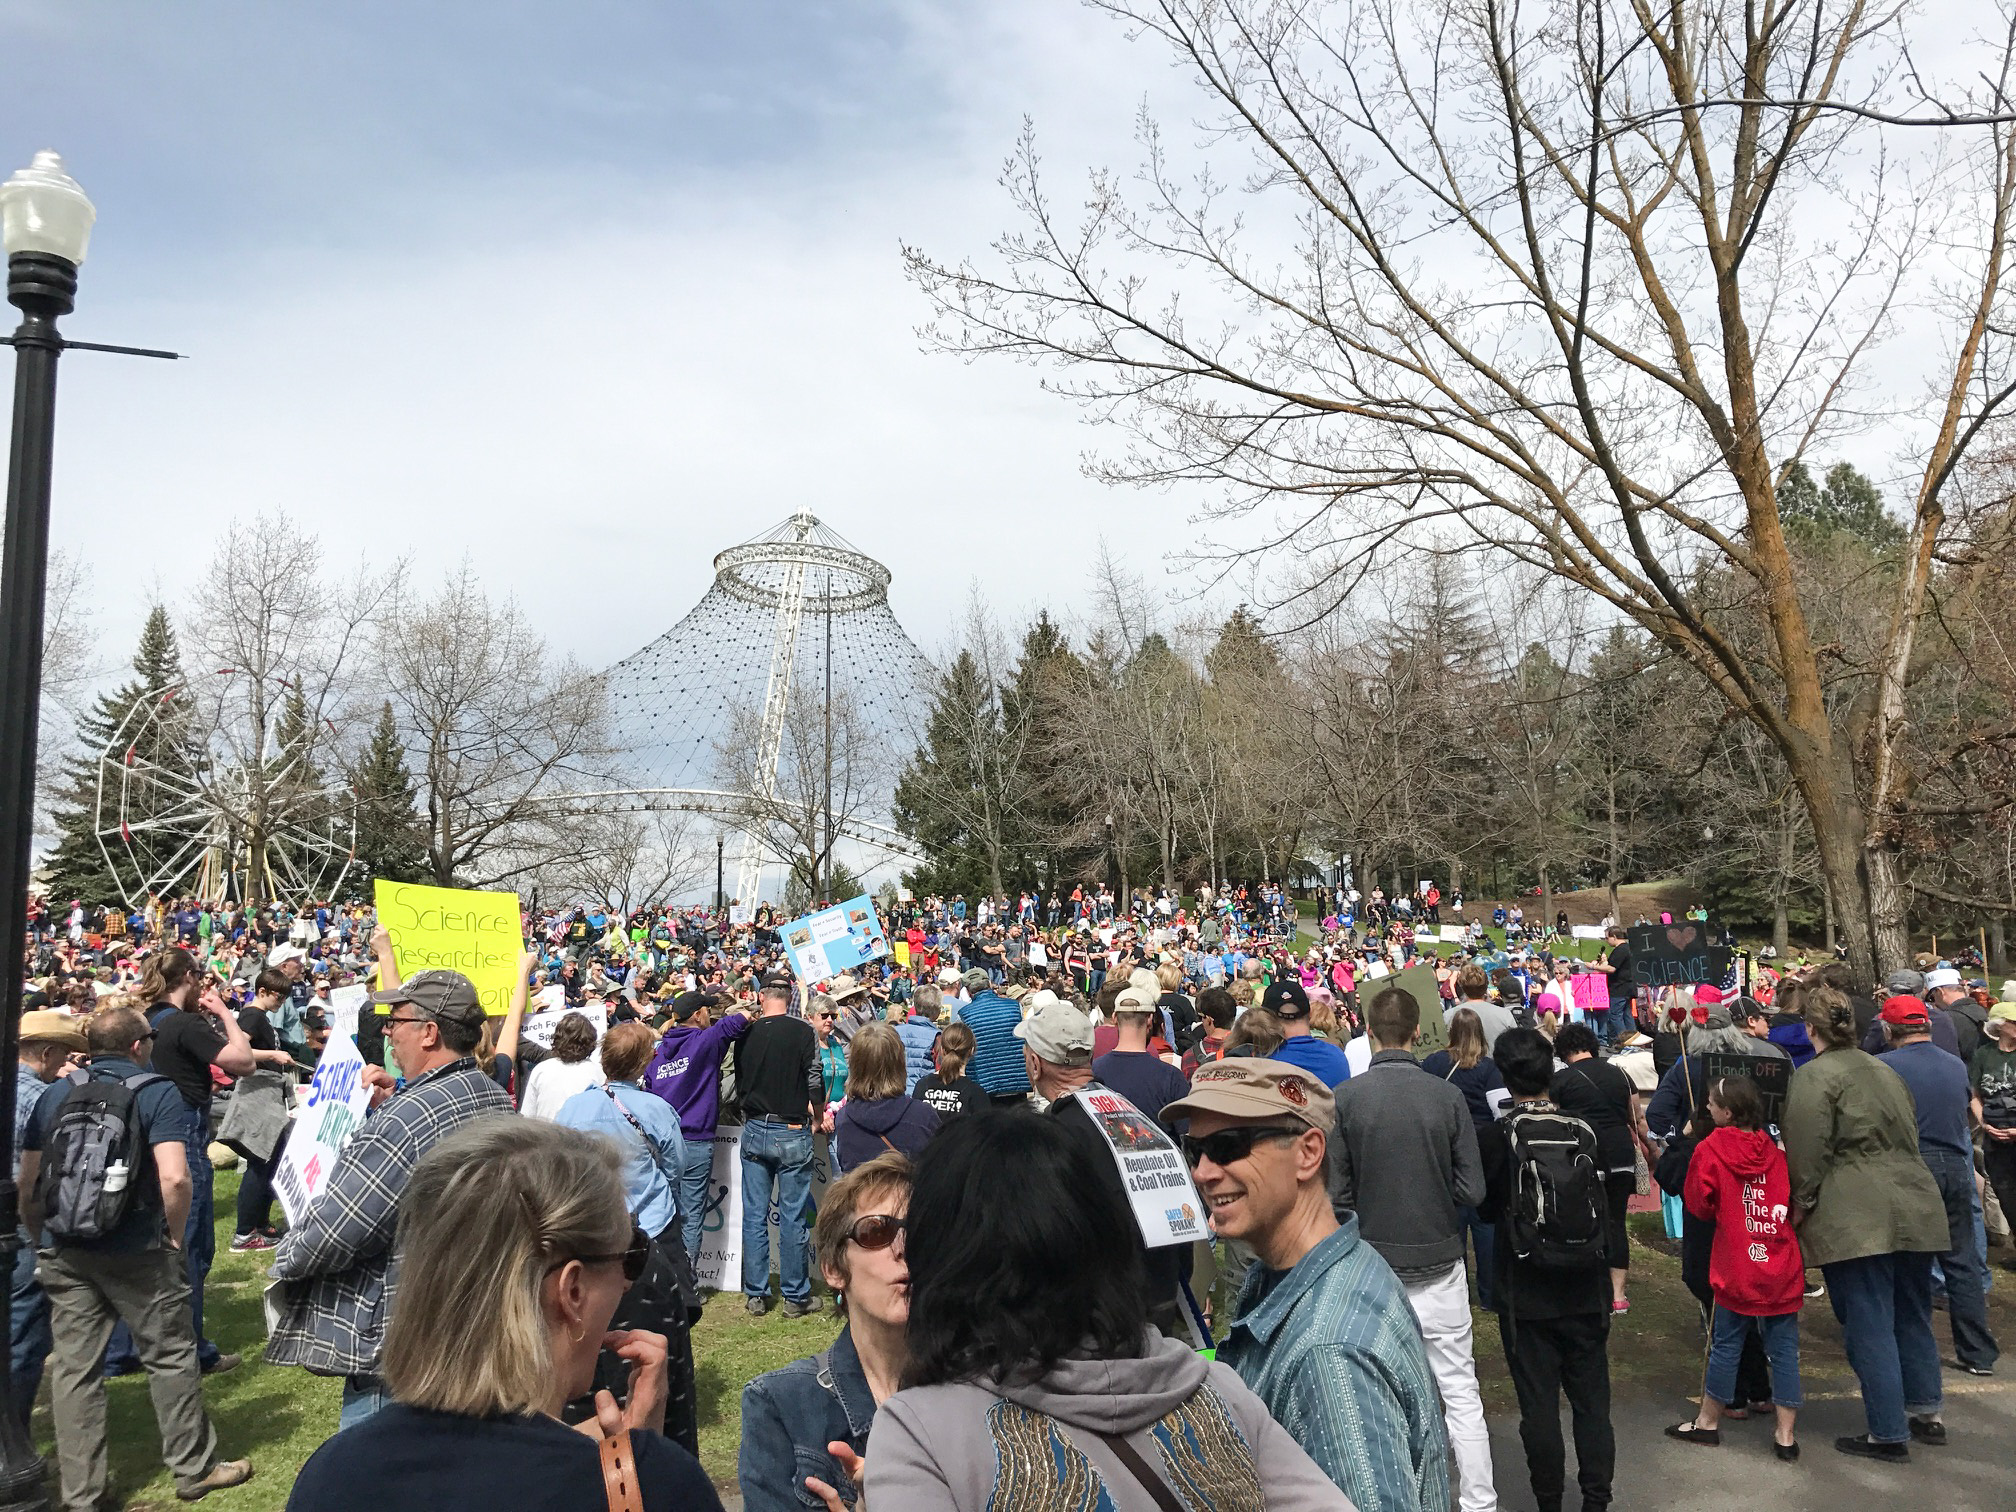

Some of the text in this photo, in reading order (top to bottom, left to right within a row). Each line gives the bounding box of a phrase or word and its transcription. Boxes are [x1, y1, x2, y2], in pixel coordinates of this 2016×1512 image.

[395, 887, 509, 934] Science
[1641, 933, 1655, 952] I
[1636, 955, 1710, 987] SCIENCE
[657, 1057, 690, 1074] SCIENCE
[1709, 1057, 1782, 1077] Hands OFF
[307, 1058, 362, 1107] SCIENCE
[924, 1089, 961, 1101] GAME
[1088, 1095, 1121, 1113] SIGN
[1123, 1152, 1178, 1174] Regulate Oil
[1128, 1171, 1187, 1192] & Coal Trains
[1742, 1184, 1765, 1200] Are
[1165, 1208, 1184, 1220] SAFER
[1743, 1200, 1769, 1217] The
[1168, 1218, 1196, 1232] SPOKANE
[1746, 1217, 1777, 1235] Ones
[715, 1250, 736, 1262] Not
